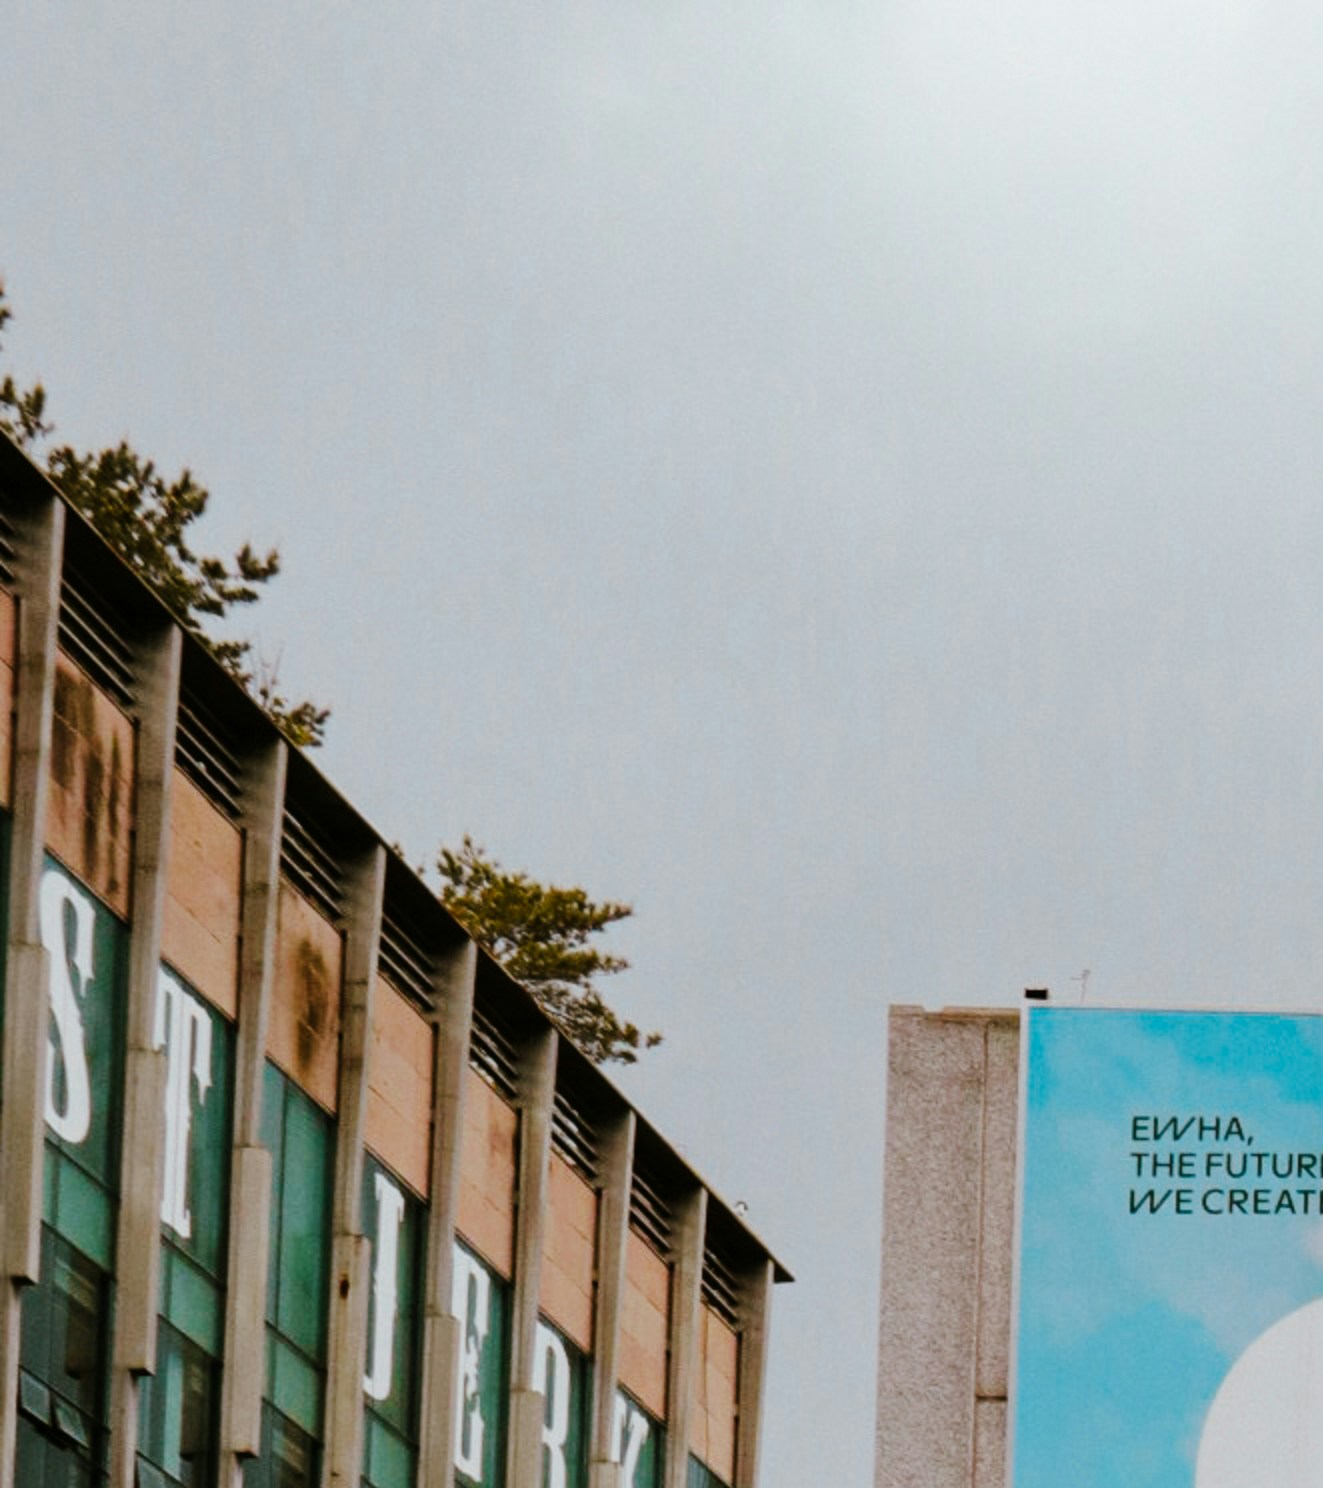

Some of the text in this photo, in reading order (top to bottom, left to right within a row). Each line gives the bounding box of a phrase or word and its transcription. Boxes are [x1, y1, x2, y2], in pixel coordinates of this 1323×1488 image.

[1131, 1115, 1254, 1147] EWHA,
[1129, 1152, 1197, 1179] THE
[1128, 1188, 1194, 1215] WE
